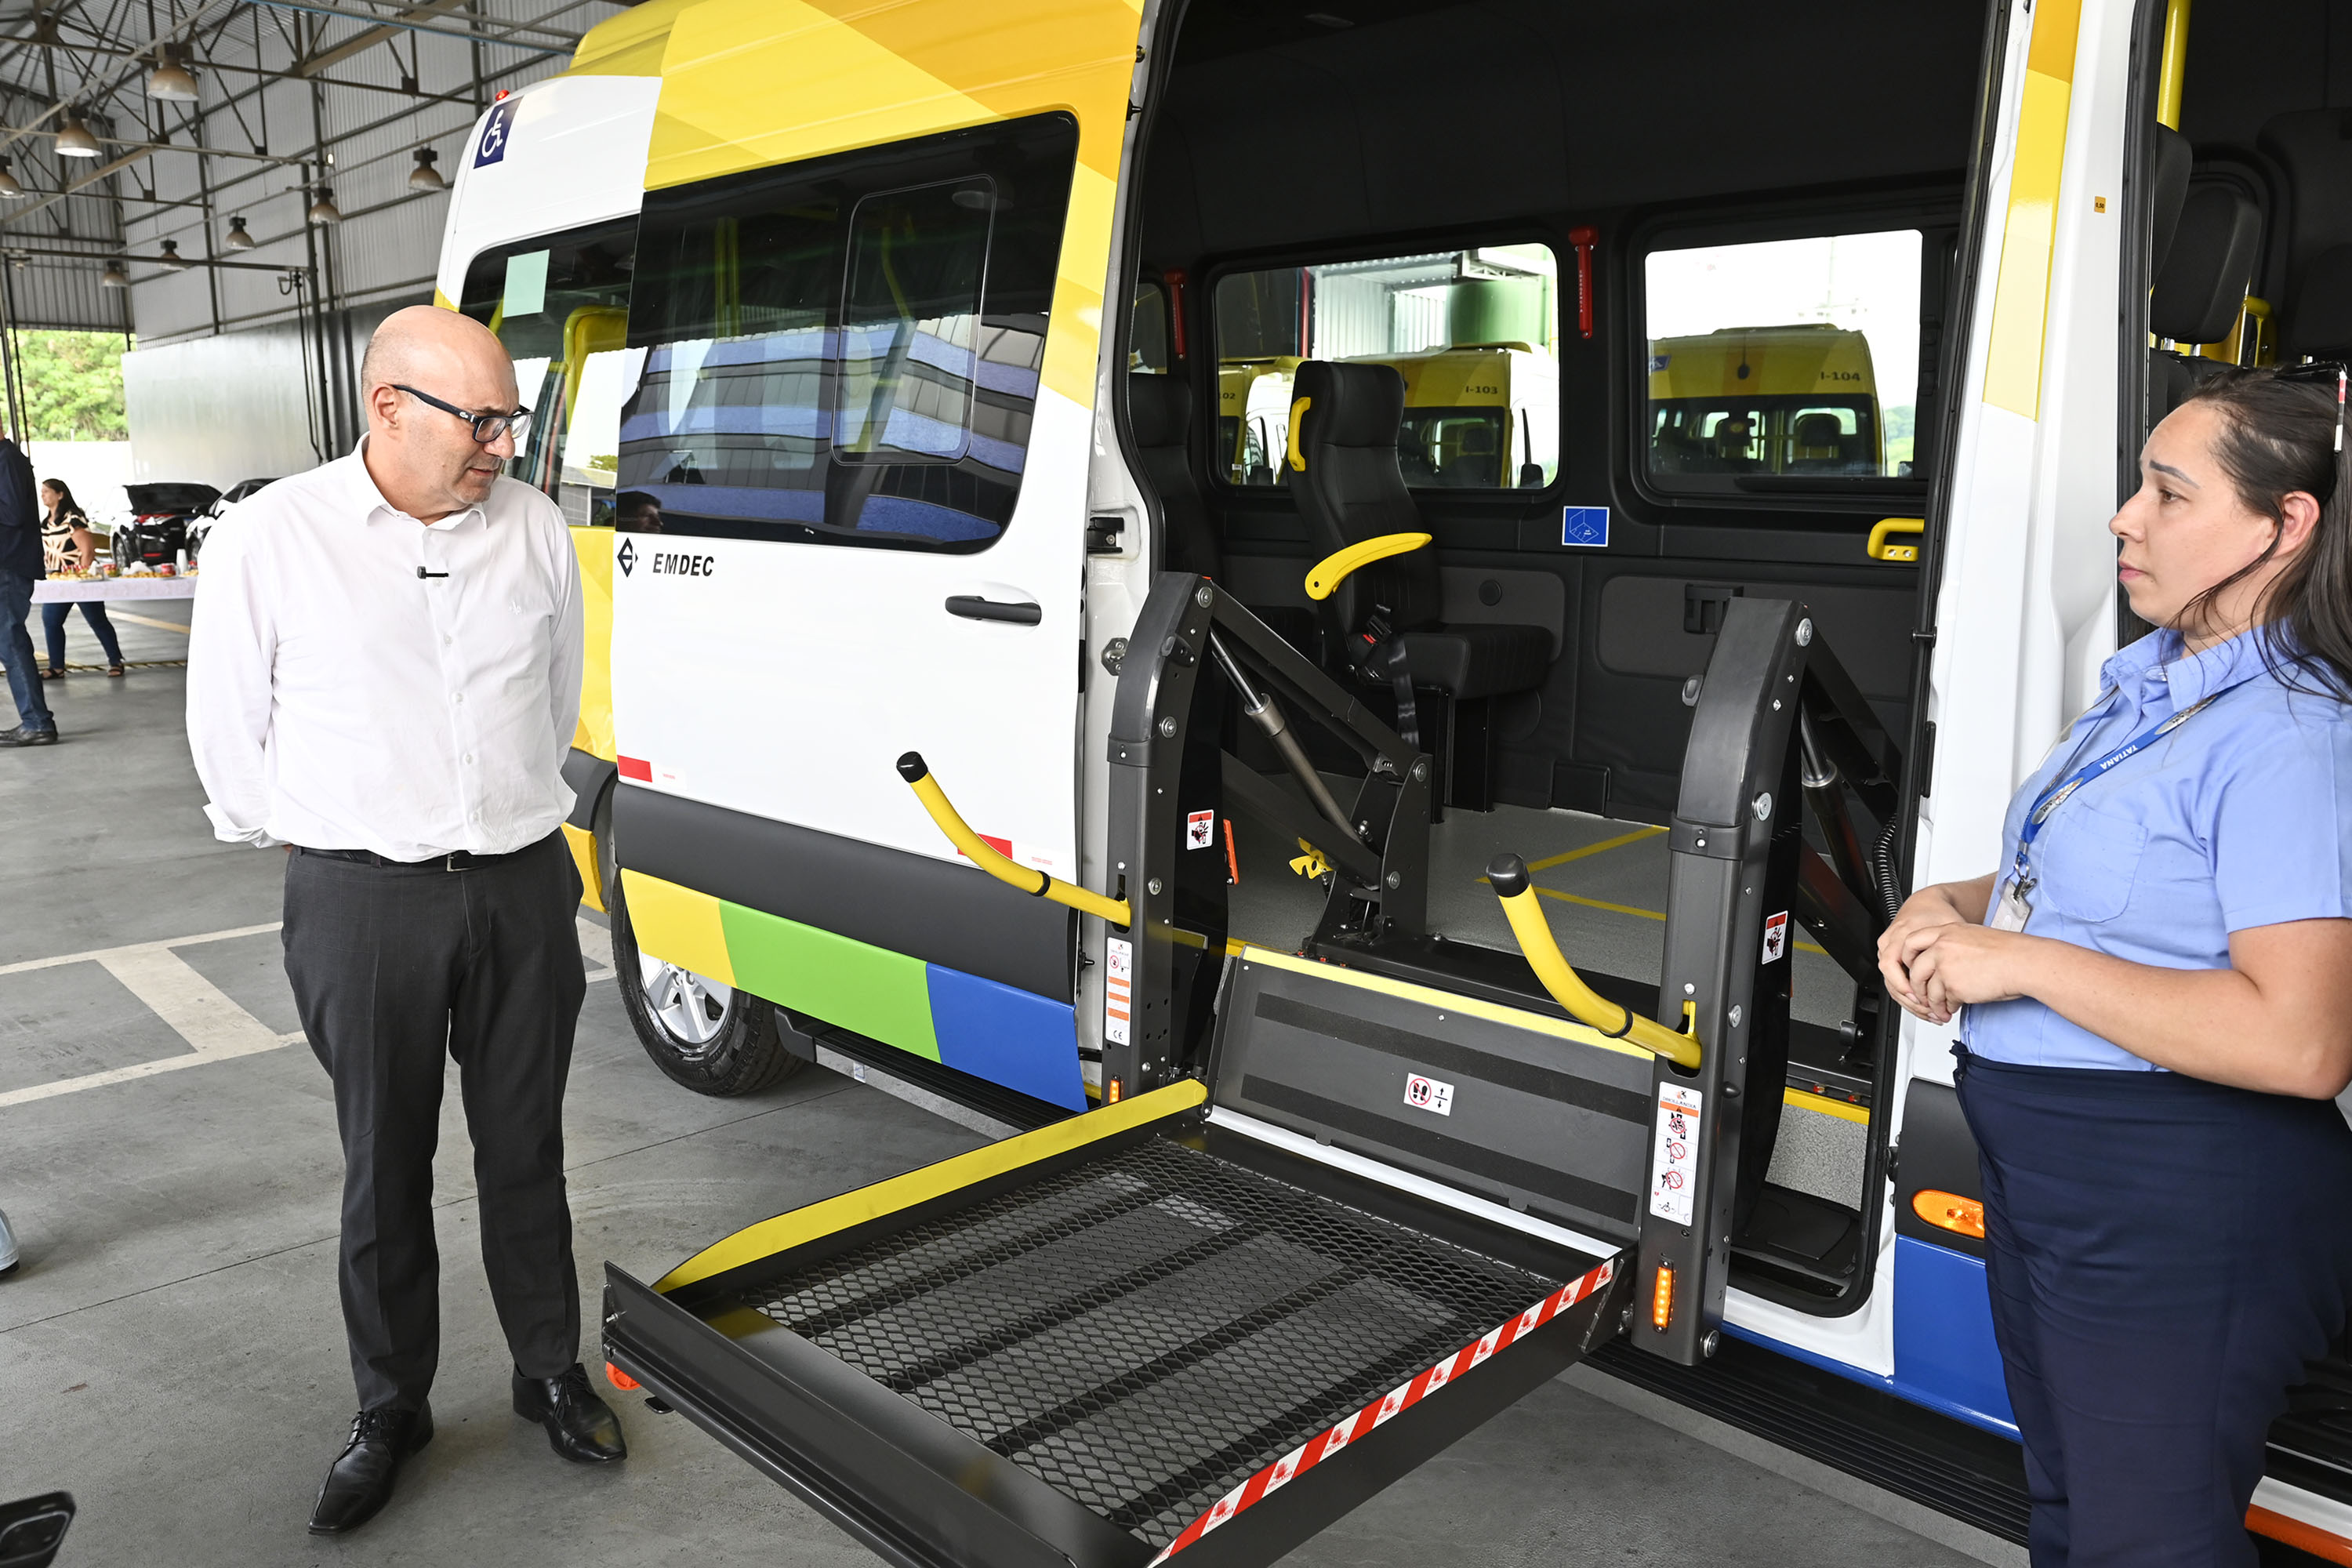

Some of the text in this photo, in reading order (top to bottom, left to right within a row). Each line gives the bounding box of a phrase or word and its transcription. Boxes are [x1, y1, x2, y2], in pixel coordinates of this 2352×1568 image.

[1820, 371, 1860, 382] I-104
[1465, 386, 1498, 394] I-103
[652, 553, 714, 577] EMDEC
[2100, 744, 2138, 770] TATIANA
[1662, 1097, 1697, 1109] DHOLLANDIA
[1325, 1436, 1348, 1454] DHOLLANDIA
[1267, 1470, 1293, 1489] DHOLLANDIA
[1207, 1508, 1233, 1527] DHOLLANDIA
